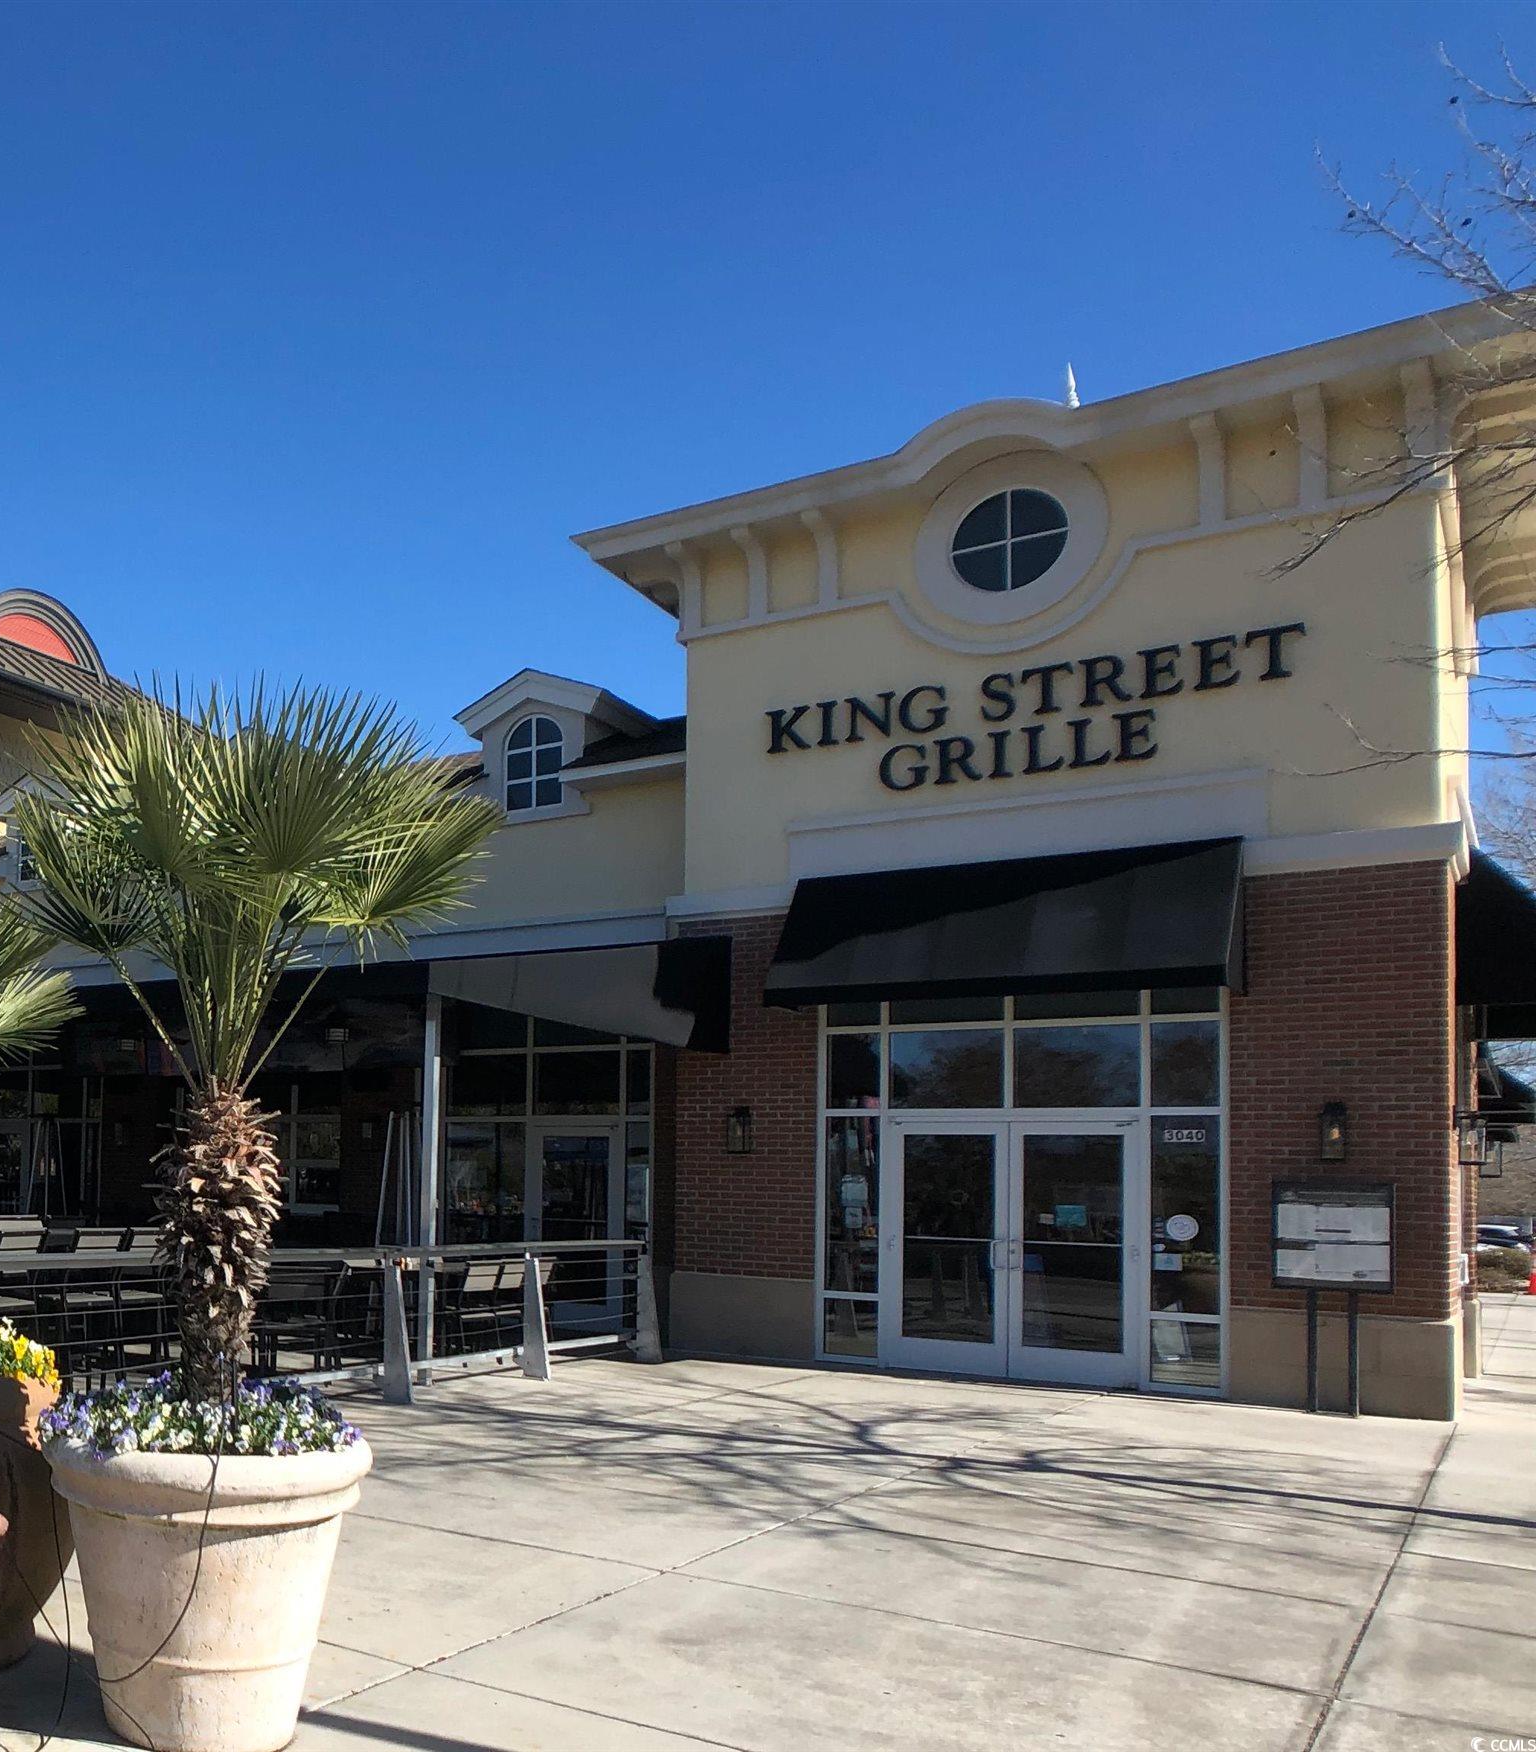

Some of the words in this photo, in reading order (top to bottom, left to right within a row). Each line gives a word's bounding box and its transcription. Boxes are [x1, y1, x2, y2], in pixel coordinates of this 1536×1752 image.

[764, 684, 949, 754] KING
[980, 621, 1307, 722] STREET
[879, 708, 1159, 792] GRILLE
[1165, 1130, 1204, 1141] 3040
